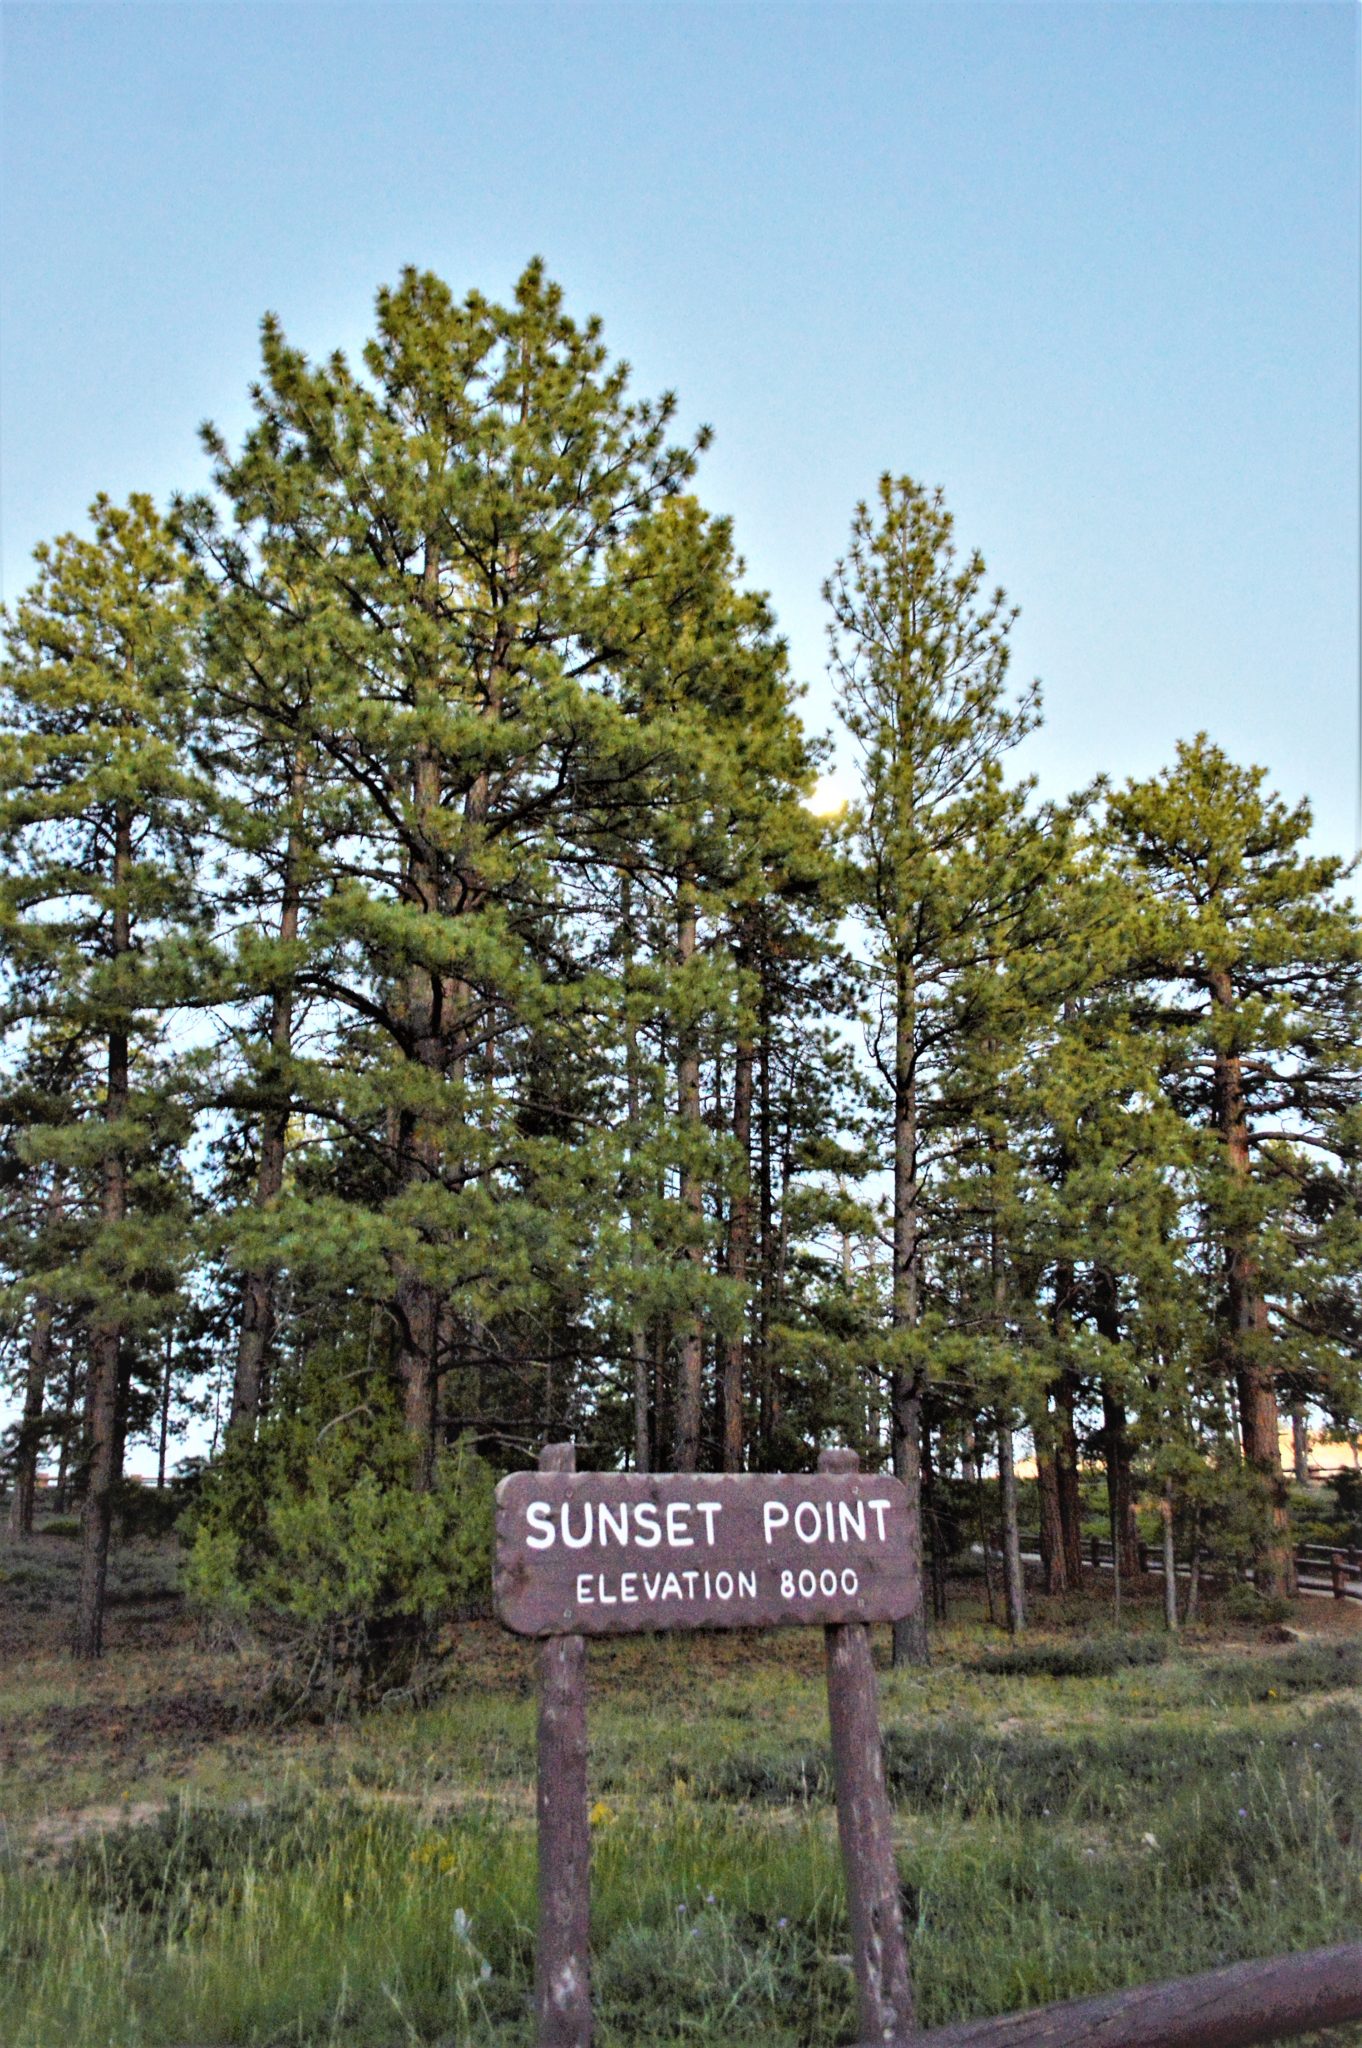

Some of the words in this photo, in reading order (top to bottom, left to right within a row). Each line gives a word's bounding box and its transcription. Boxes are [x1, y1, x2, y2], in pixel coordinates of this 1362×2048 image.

[525, 1501, 723, 1550] SUNSET
[763, 1499, 891, 1545] POINT
[576, 1570, 757, 1604] ELEVATION
[780, 1568, 859, 1599] 8000
